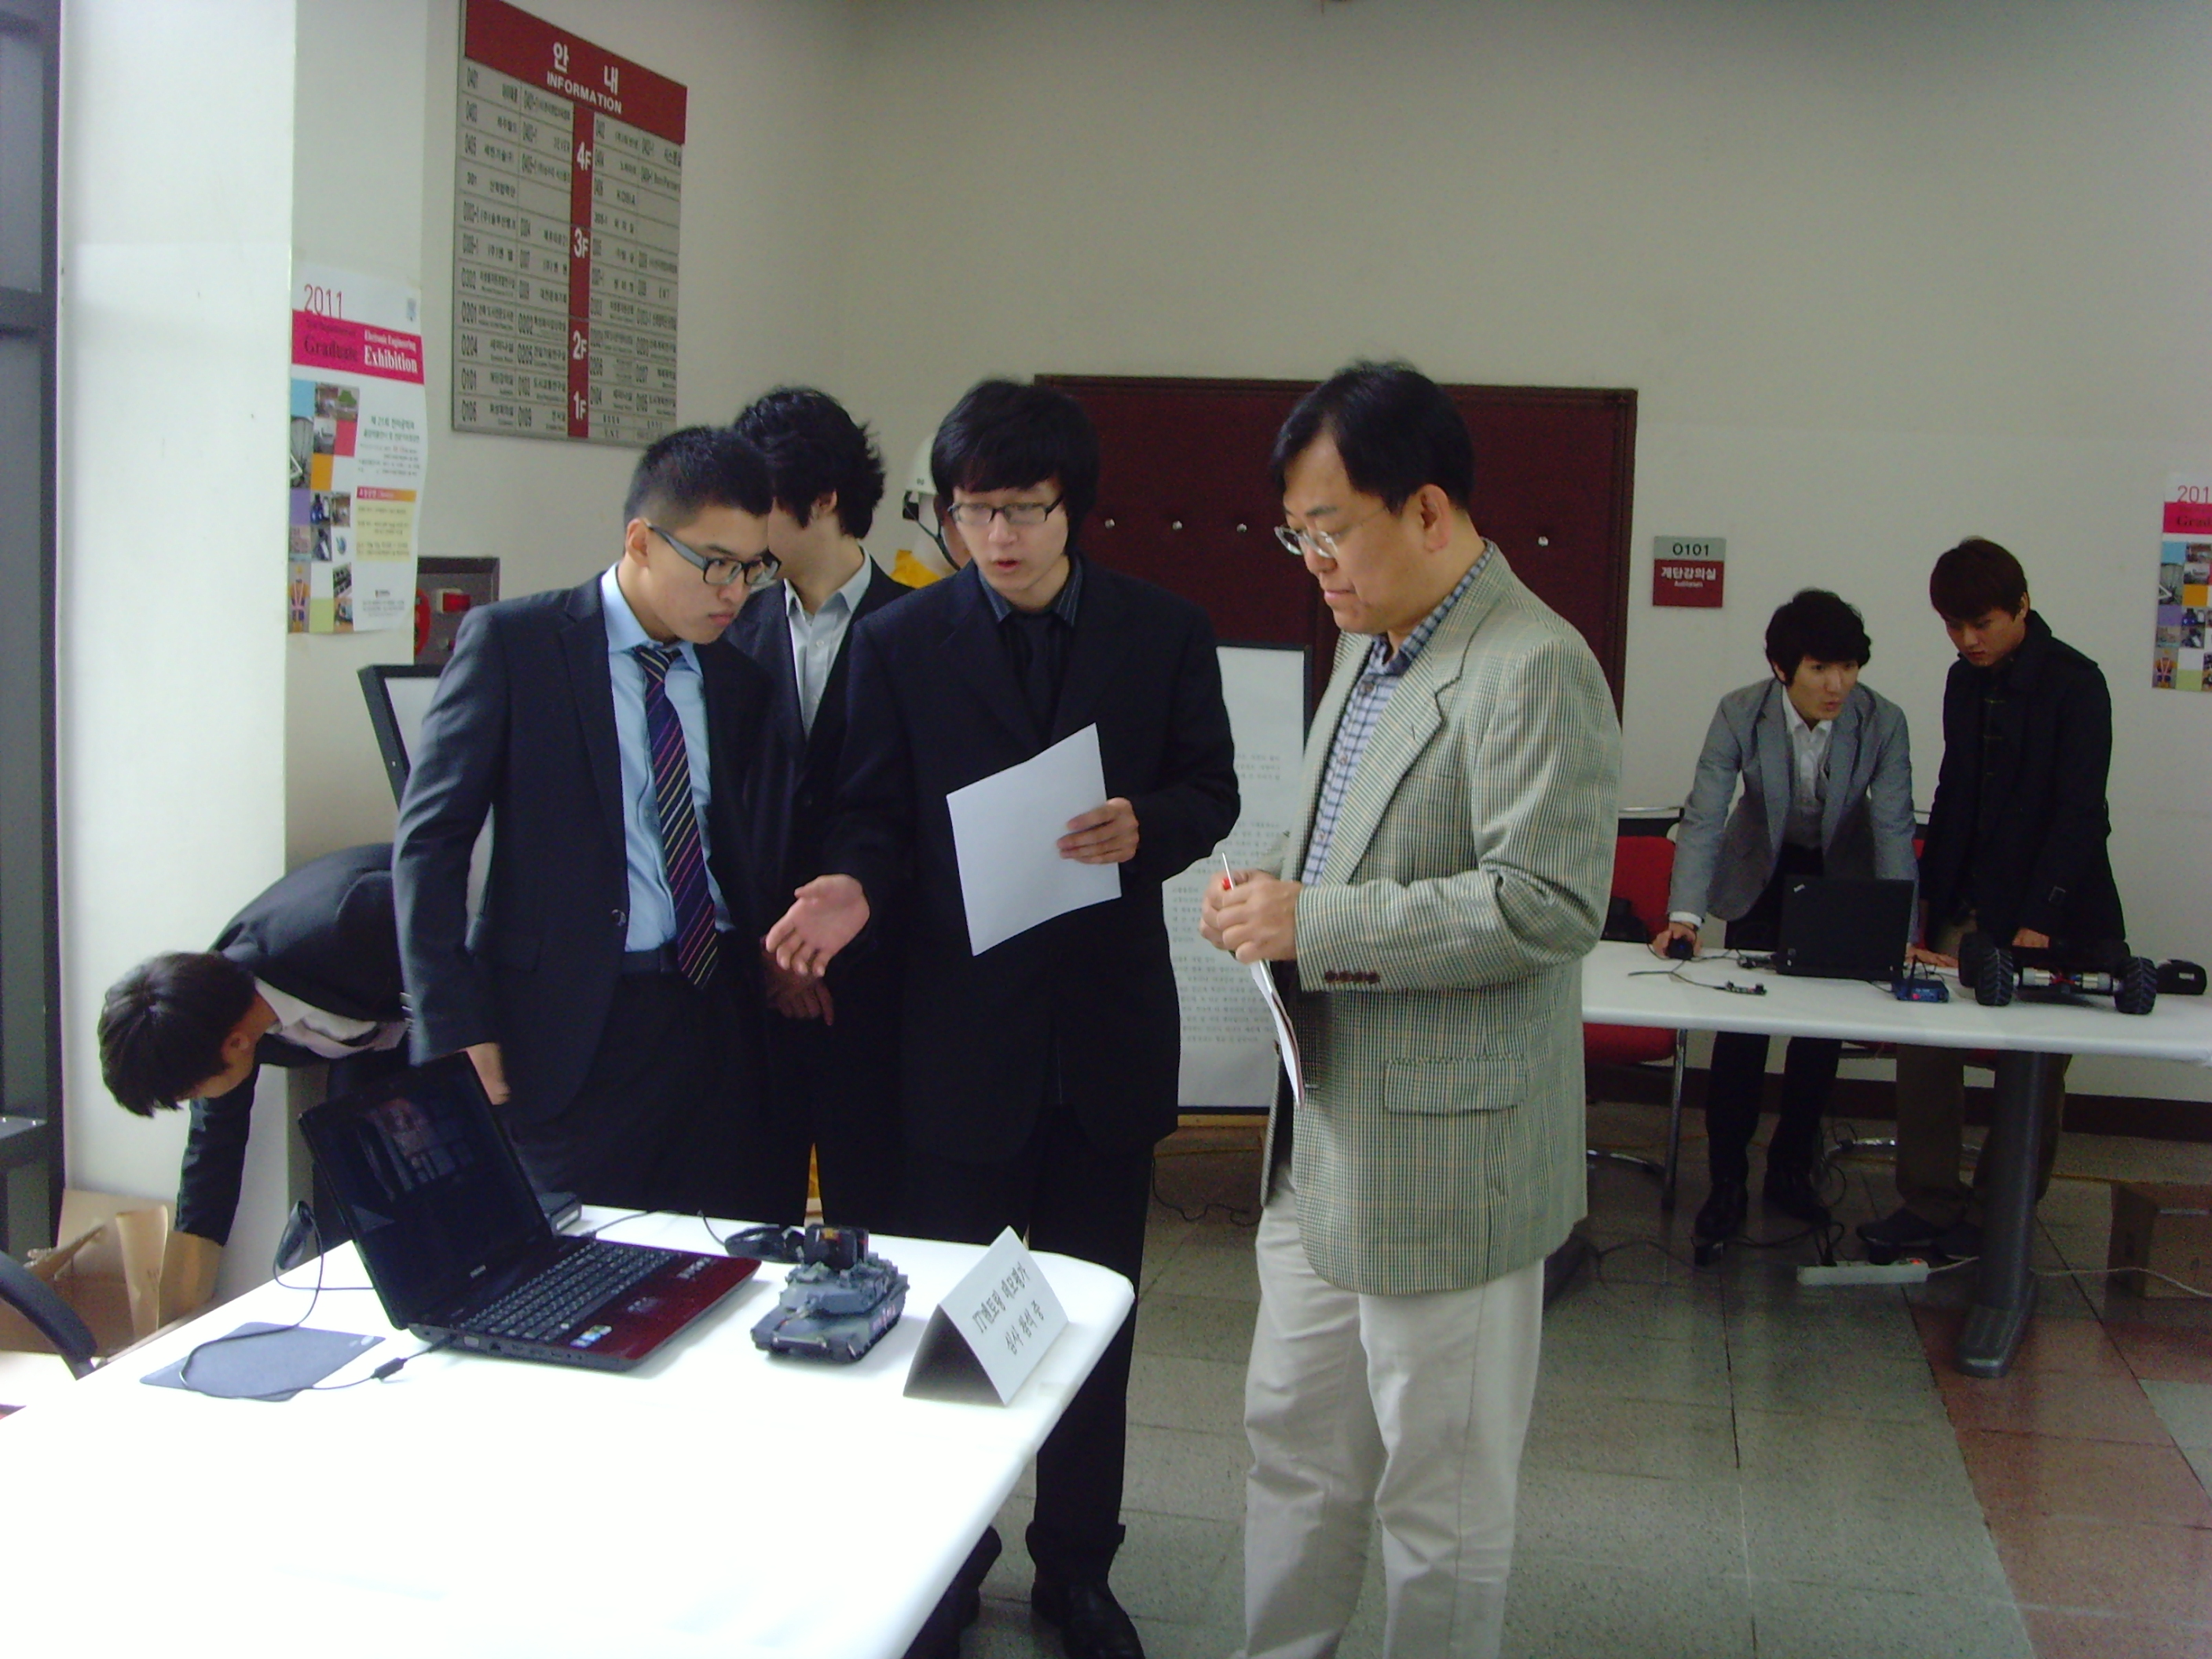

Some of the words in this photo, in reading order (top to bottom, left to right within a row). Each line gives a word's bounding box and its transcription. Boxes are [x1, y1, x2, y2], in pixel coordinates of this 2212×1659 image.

[553, 42, 569, 74] 안
[603, 64, 619, 96] 내
[547, 71, 622, 115] INFORMATION
[577, 141, 591, 171] 4F
[573, 227, 589, 258] 3F
[304, 284, 342, 319] 2011
[364, 344, 418, 374] Exhibition
[573, 330, 588, 361] 2F
[573, 390, 587, 420] 1F
[1661, 566, 1716, 580] 계단강의실
[1002, 1261, 1031, 1299] 데모평가
[1005, 1324, 1024, 1355] 심사
[1031, 1299, 1045, 1321] 중
